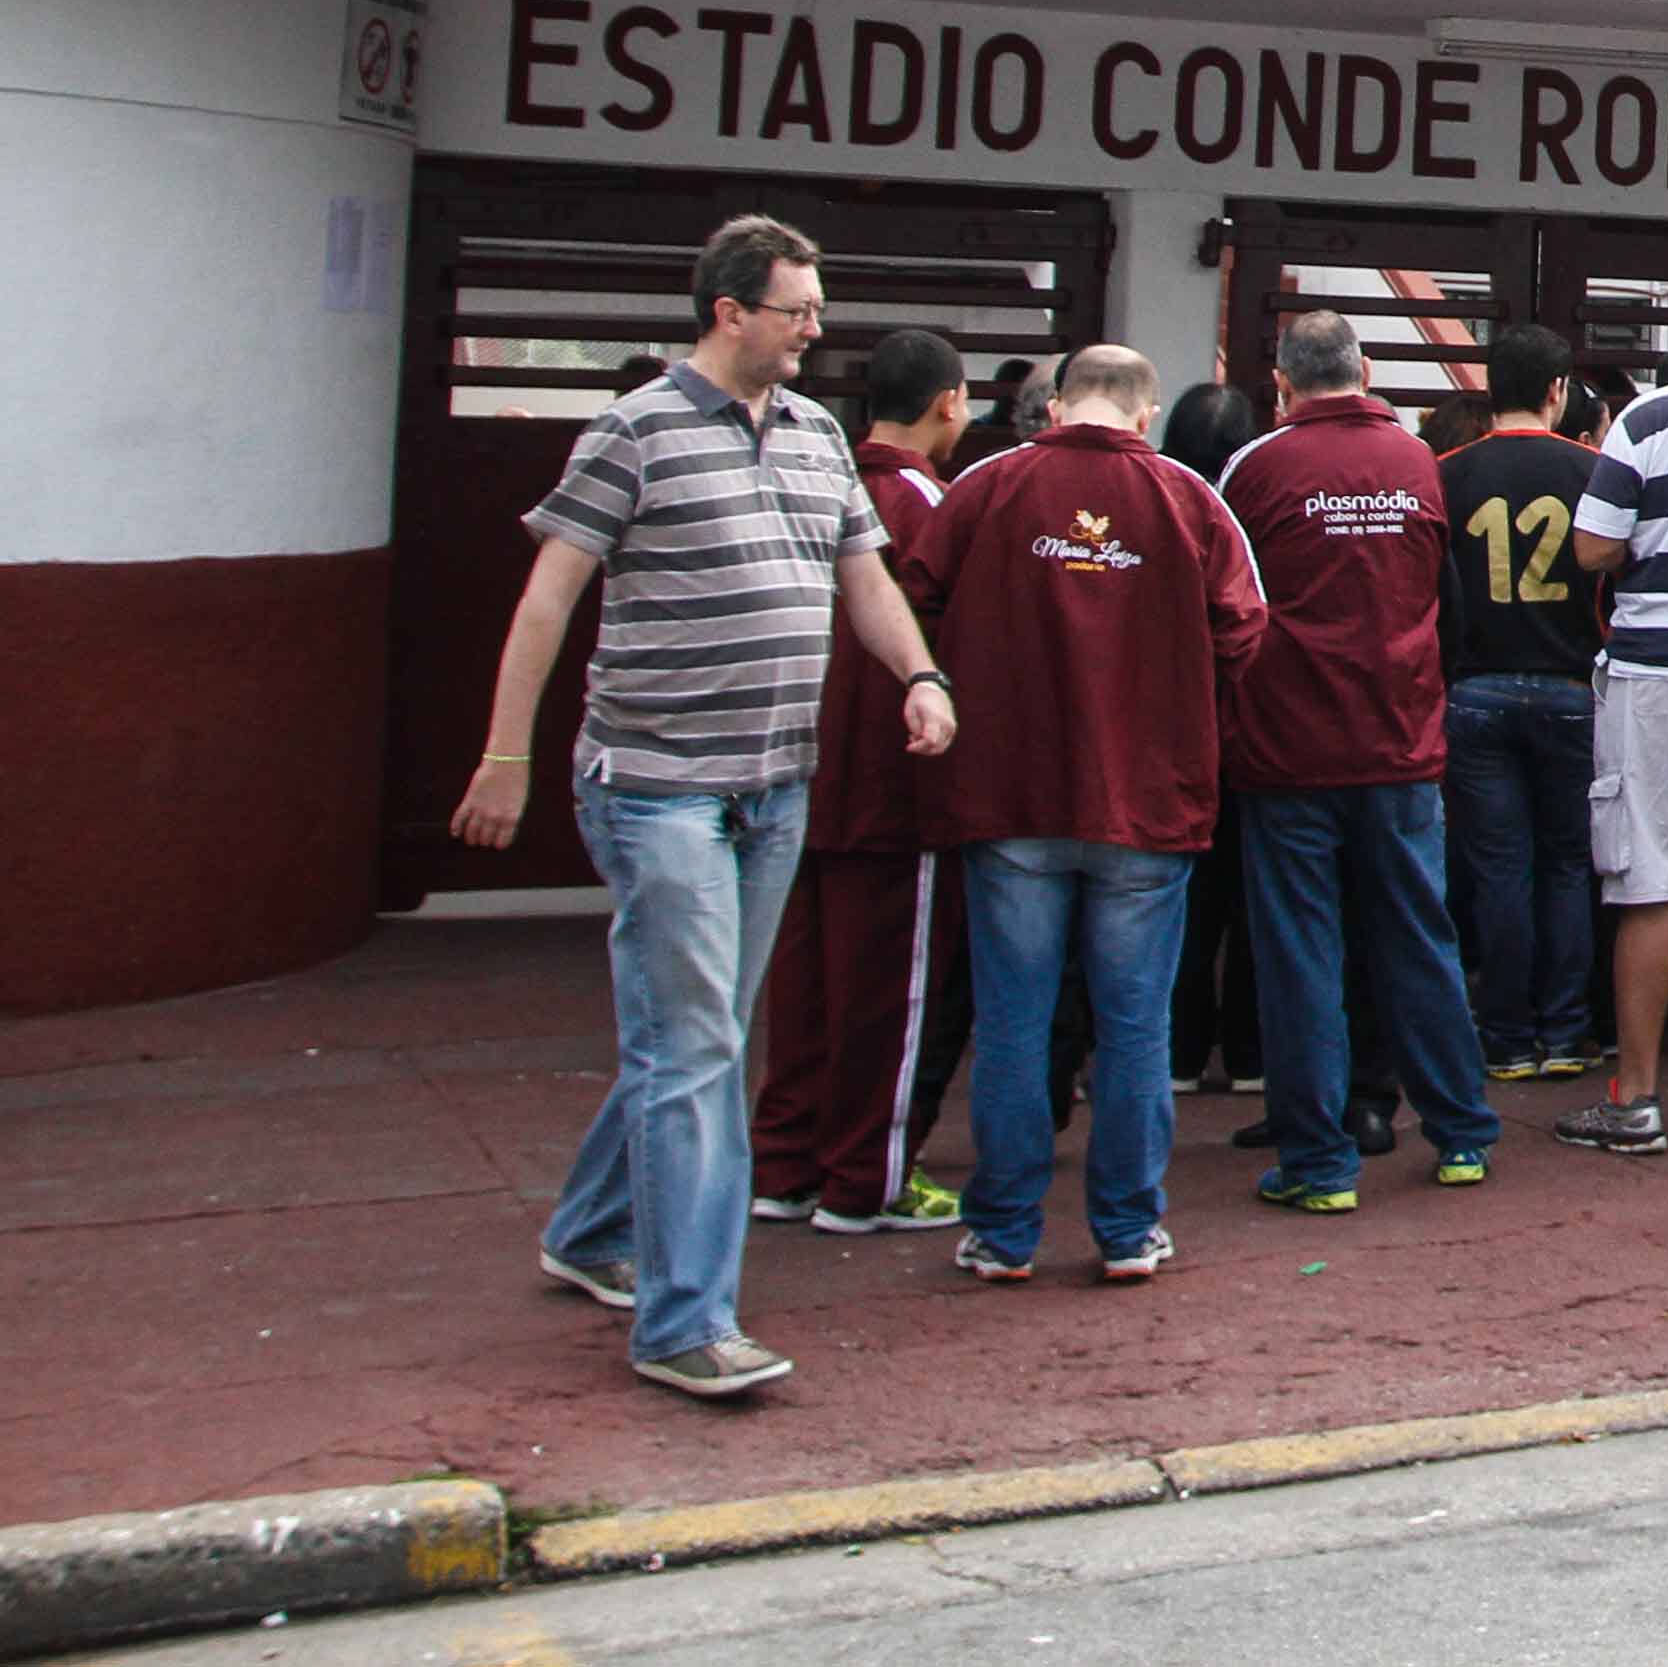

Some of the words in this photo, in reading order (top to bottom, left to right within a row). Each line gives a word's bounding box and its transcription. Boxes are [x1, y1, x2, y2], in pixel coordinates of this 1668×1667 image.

[1091, 40, 1481, 179] CONDE
[1305, 489, 1419, 517] plasmódia
[1466, 495, 1570, 604] 12
